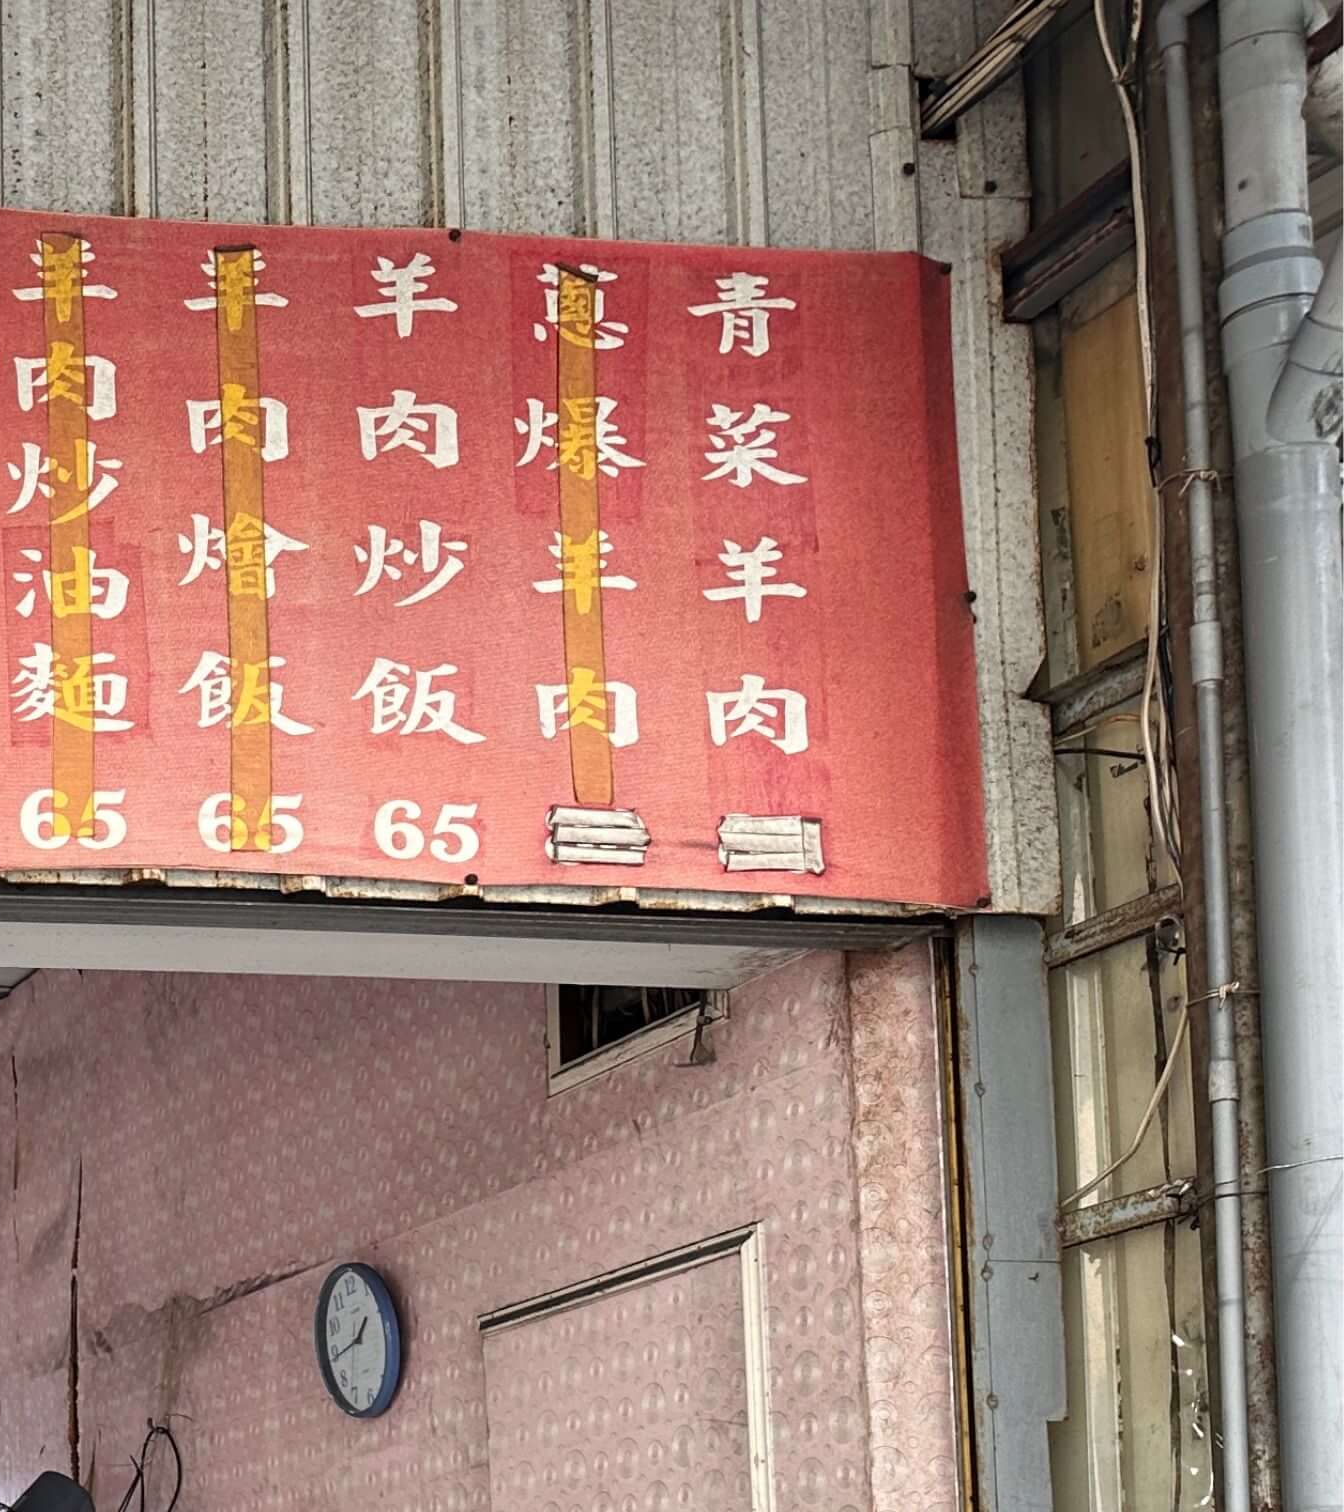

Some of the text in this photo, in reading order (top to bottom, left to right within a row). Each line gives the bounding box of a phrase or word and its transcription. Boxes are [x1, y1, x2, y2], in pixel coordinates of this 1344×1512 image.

[7, 236, 135, 852] 羊肉炒油麵 65
[178, 247, 315, 856] 羊肉燴飯 65
[352, 251, 486, 864] 羊肉炒飯 65
[687, 270, 809, 755] 青菜羊肉
